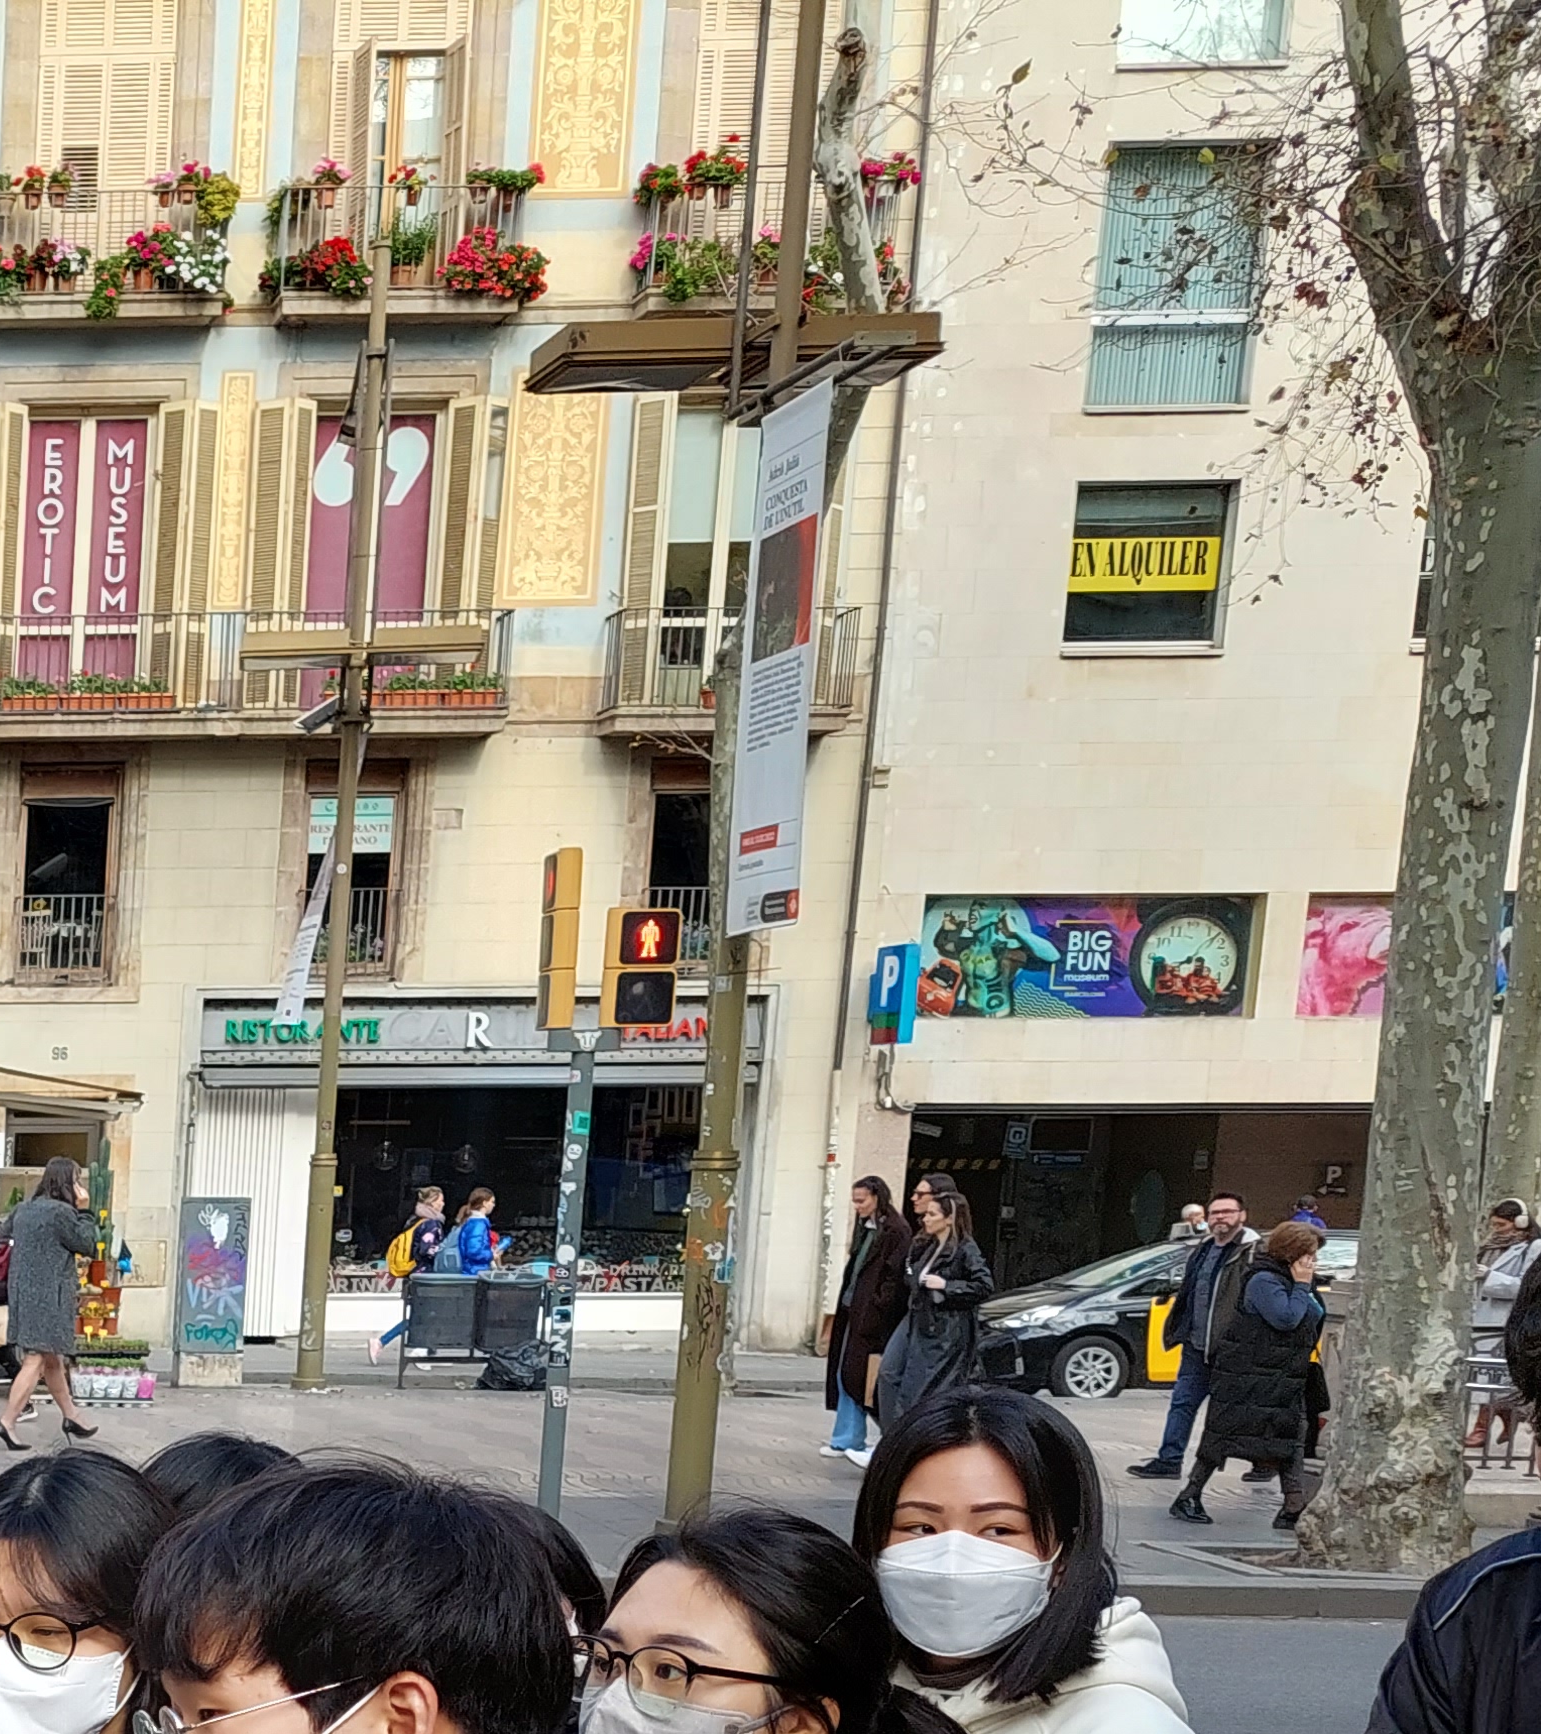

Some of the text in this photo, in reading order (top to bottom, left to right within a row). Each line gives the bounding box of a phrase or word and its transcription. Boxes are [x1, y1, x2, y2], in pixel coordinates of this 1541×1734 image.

[30, 438, 62, 615] EROTIC
[99, 437, 135, 612] MUSEUM
[1070, 540, 1209, 585] EN ALQUILER
[1068, 931, 1113, 952] BIG
[1066, 952, 1112, 971] FUN
[880, 955, 900, 1007] P
[1064, 973, 1110, 982] museum
[51, 1046, 69, 1061] 96
[1325, 1165, 1342, 1184] P
[596, 1277, 665, 1292] PASTA
